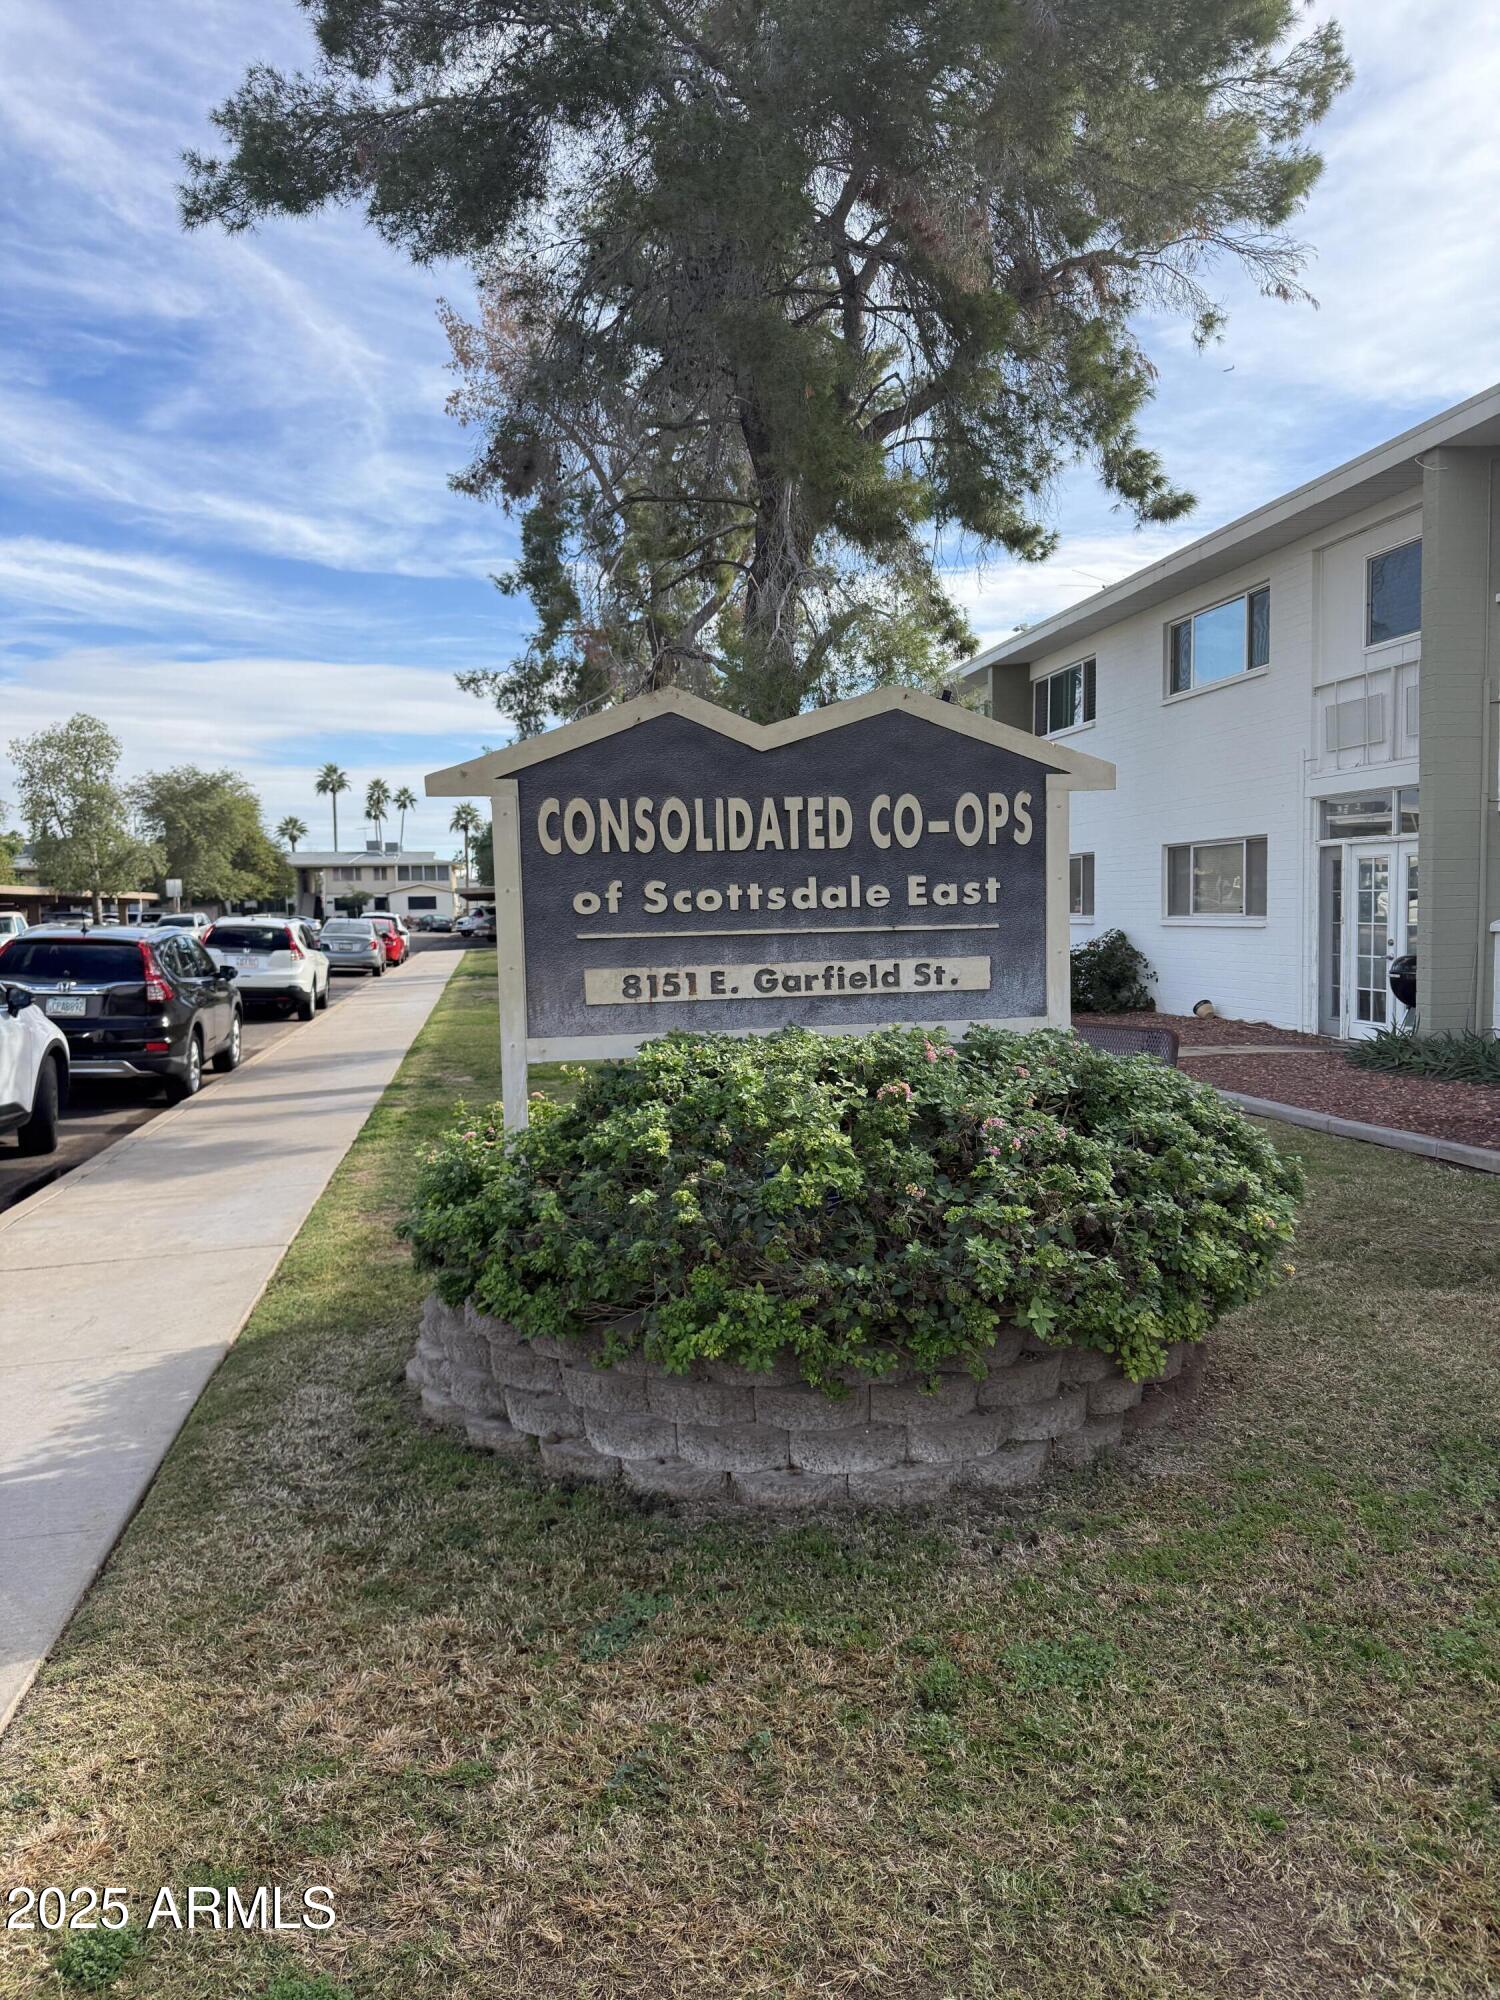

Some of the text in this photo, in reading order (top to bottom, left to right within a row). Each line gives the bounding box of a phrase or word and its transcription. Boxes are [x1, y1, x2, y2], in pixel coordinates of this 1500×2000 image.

[538, 792, 1033, 854] CONSOLIDATED CO-OPS
[573, 875, 1002, 915] of Scottsdale East
[622, 962, 959, 999] 8151 E. Garfield St.
